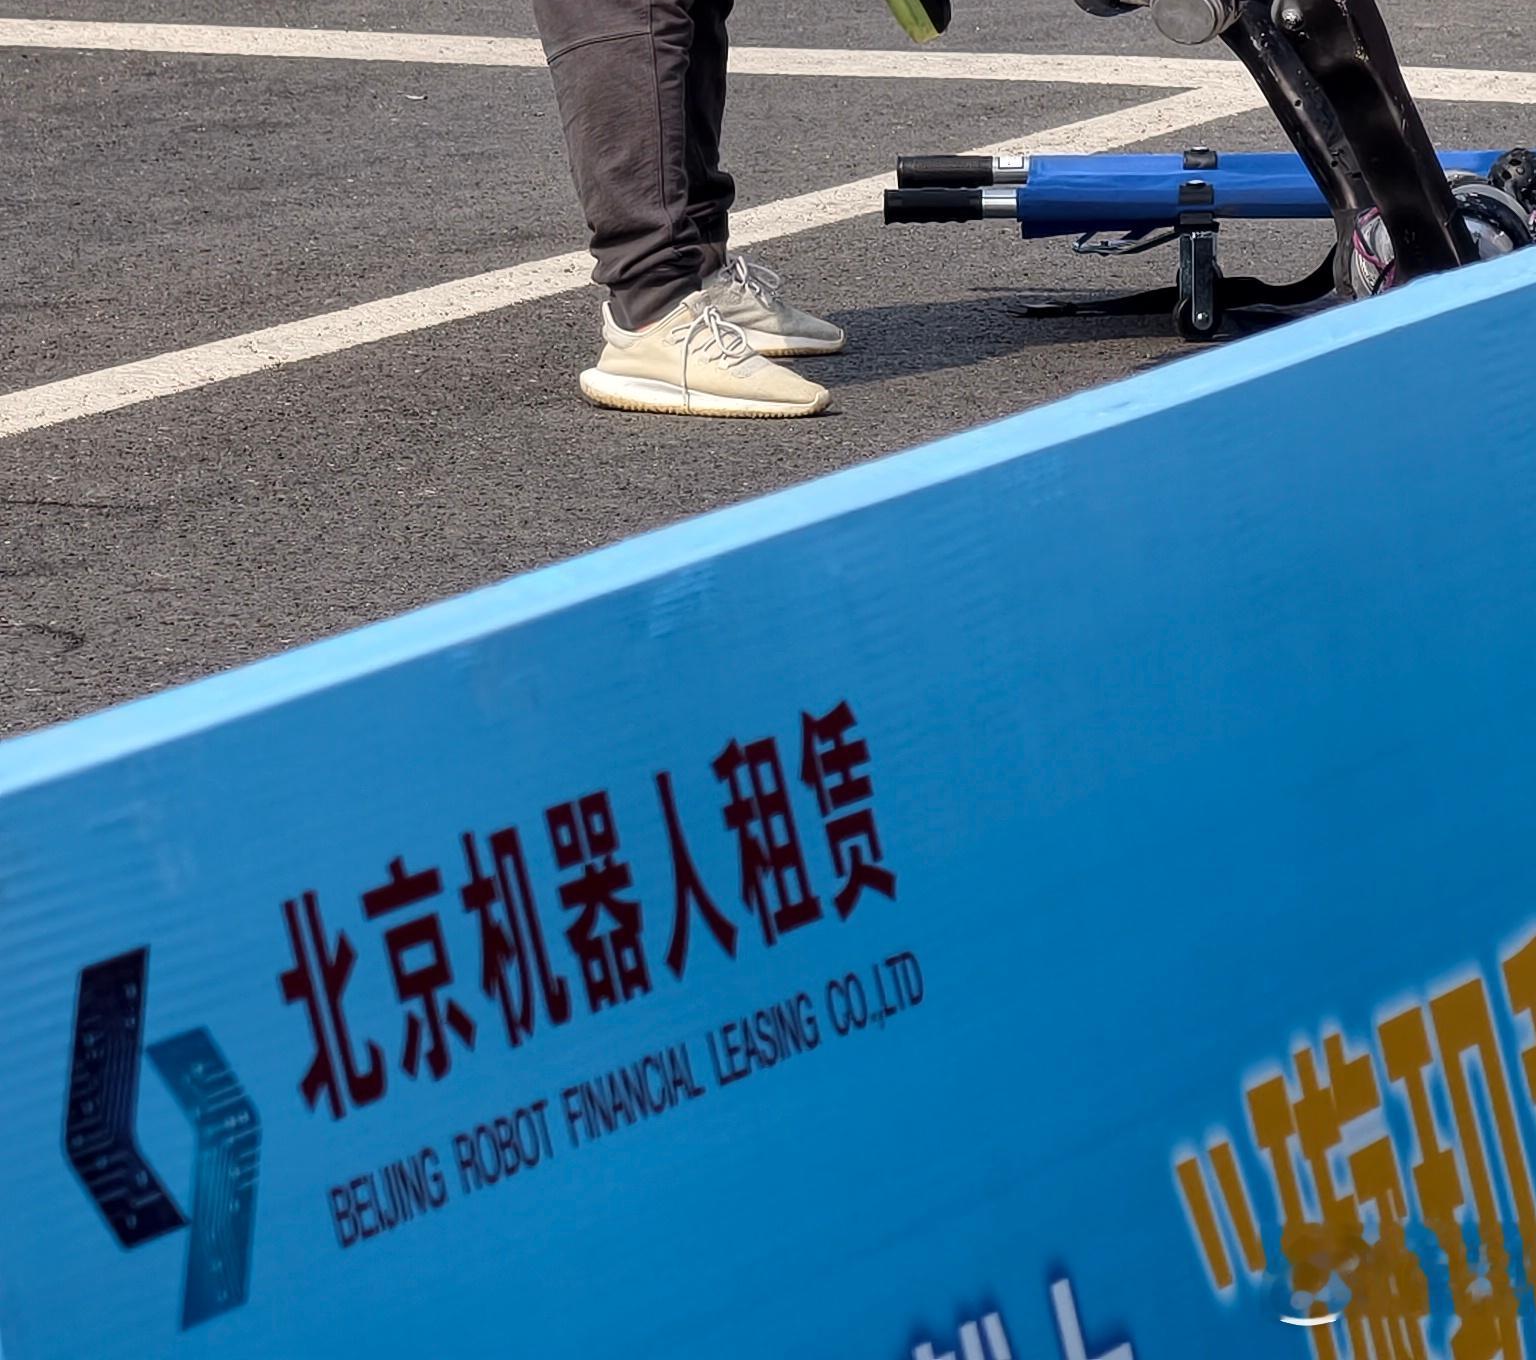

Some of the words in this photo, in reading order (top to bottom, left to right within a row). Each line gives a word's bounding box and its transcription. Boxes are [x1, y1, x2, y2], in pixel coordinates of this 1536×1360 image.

[279, 699, 898, 1122] 北京机器人租赁
[328, 1149, 448, 1249] BEIJING
[453, 1097, 556, 1194] ROBOT
[563, 1049, 705, 1148] FINANCIAL
[705, 993, 822, 1087] LEASING
